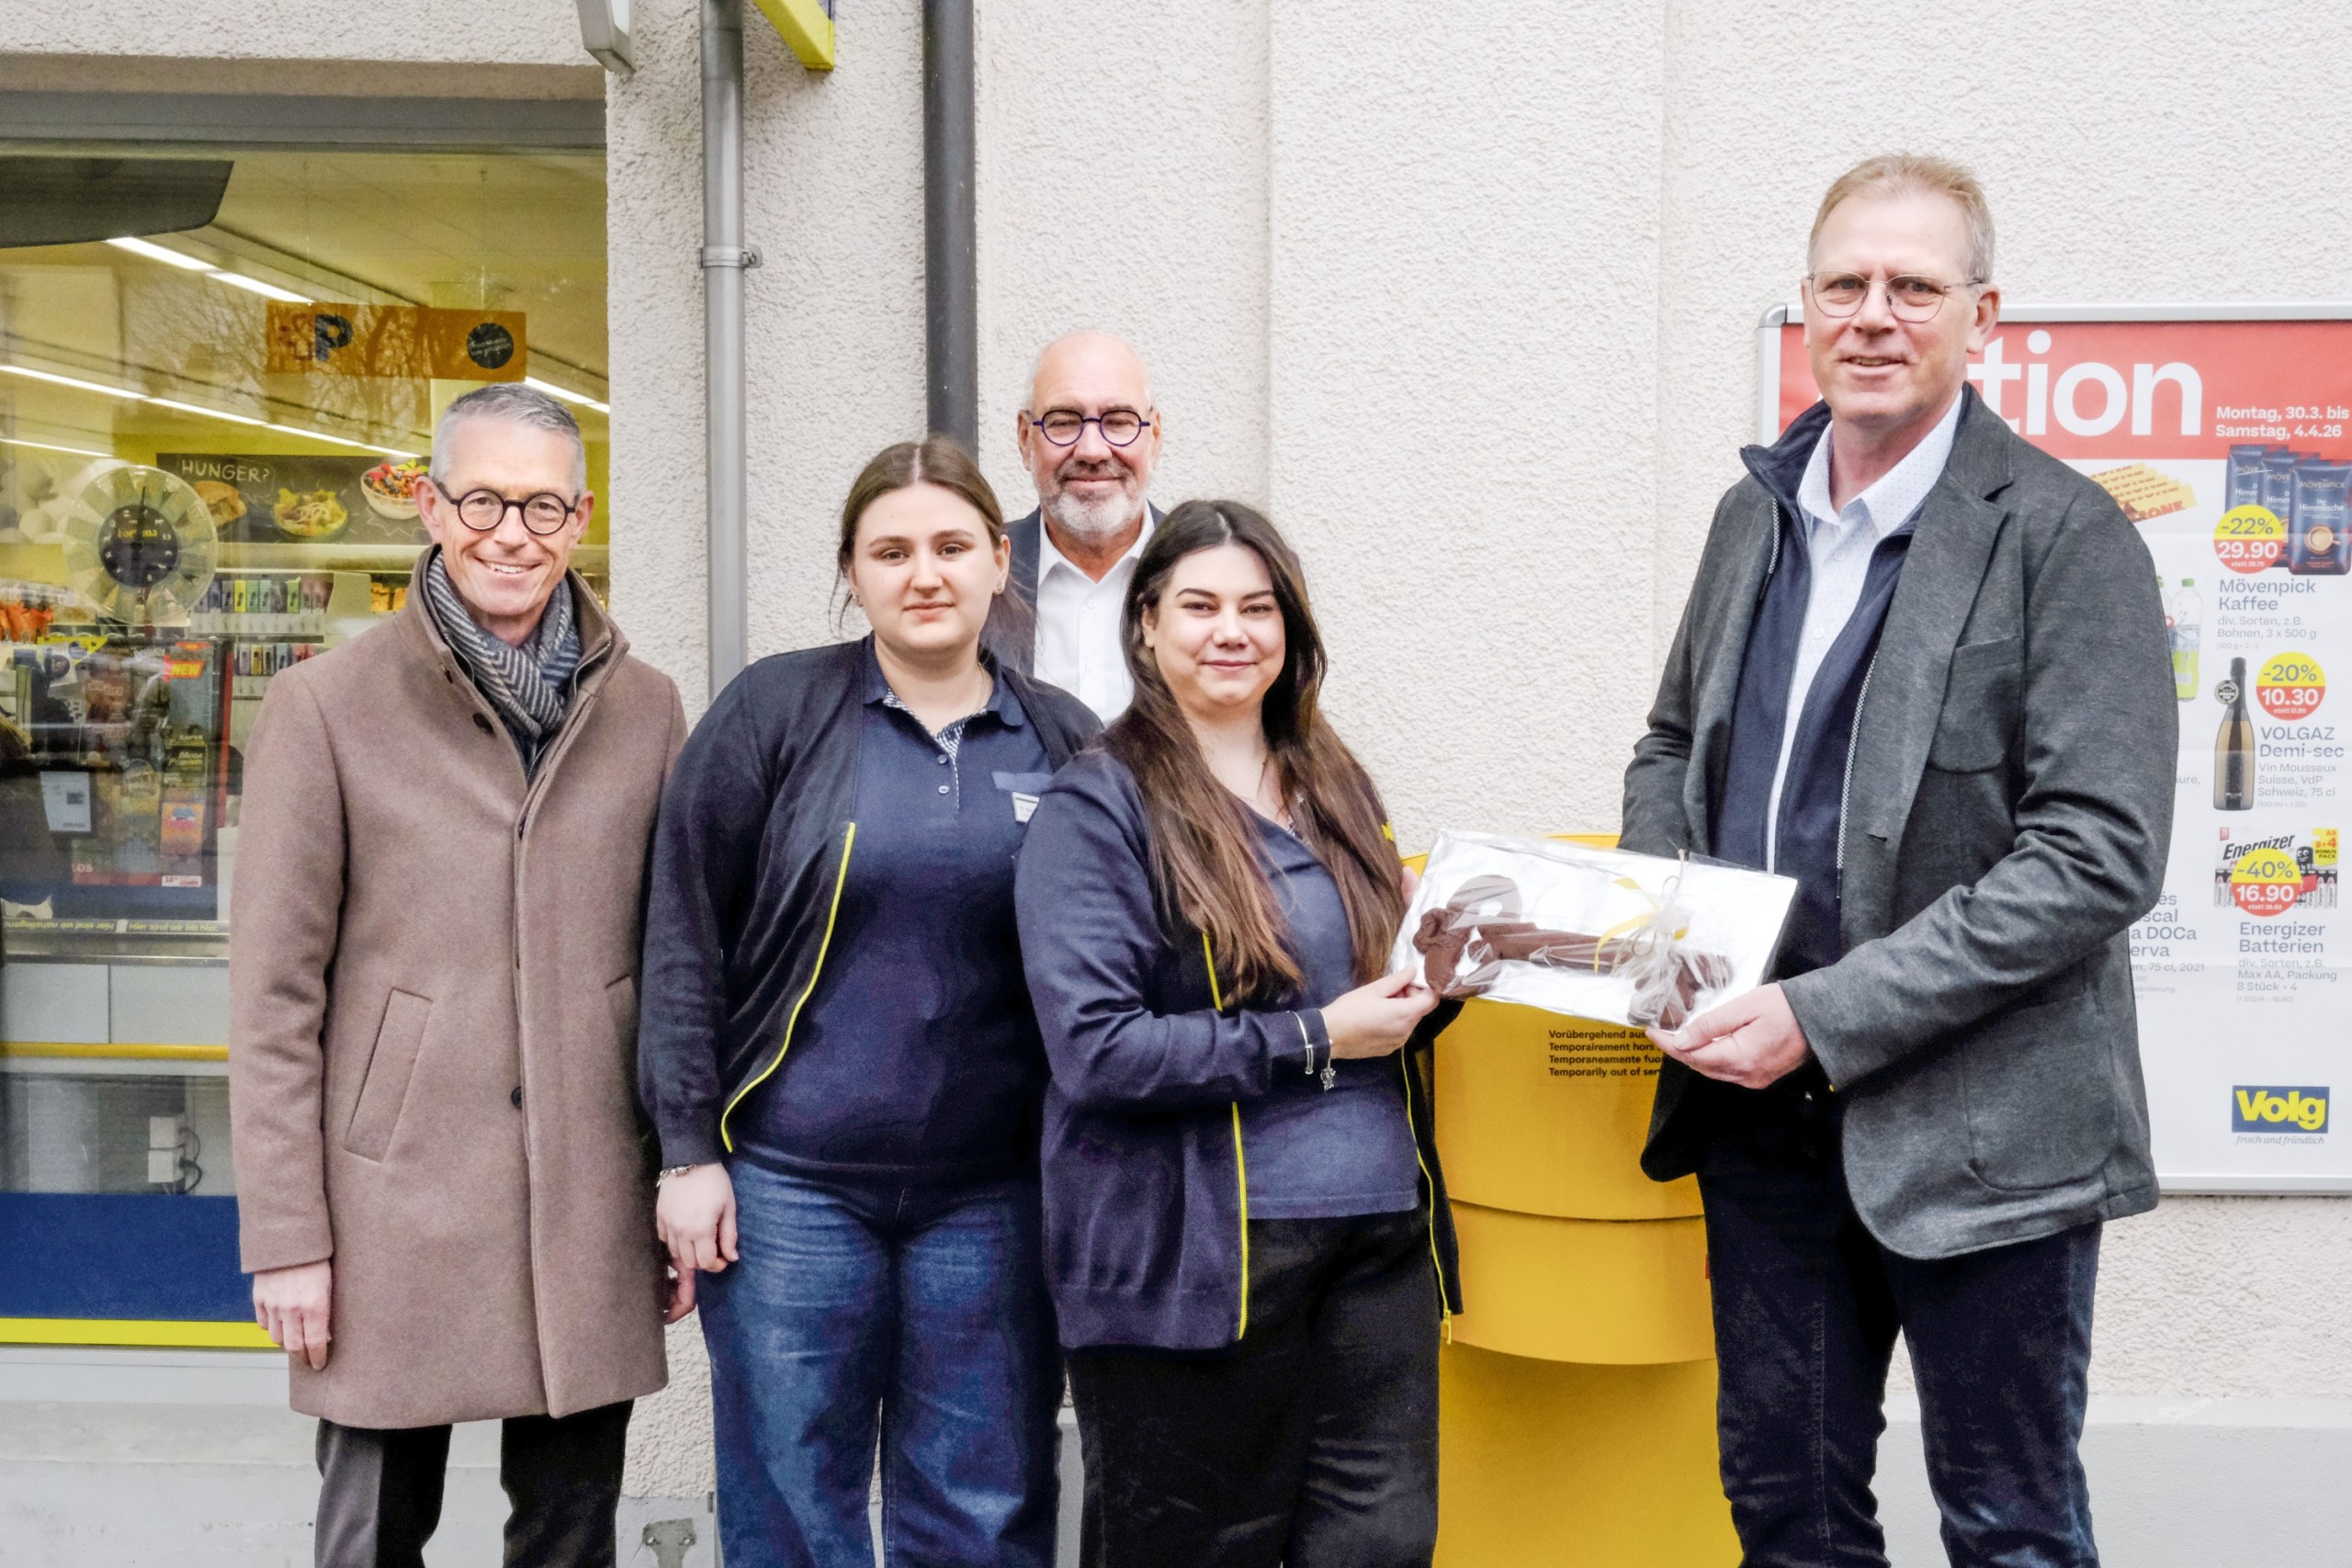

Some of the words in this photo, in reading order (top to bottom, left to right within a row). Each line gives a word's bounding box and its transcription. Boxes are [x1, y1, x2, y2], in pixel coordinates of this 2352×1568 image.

[2217, 406, 2282, 422] Montag,
[2286, 406, 2324, 419] 30.3.
[2327, 406, 2349, 419] bis
[2216, 424, 2290, 440] Samstag,
[2294, 424, 2342, 437] 4.4.26
[182, 460, 270, 482] HUNGER?
[2222, 517, 2274, 535] -22%
[2218, 541, 2278, 558] 29.90
[2220, 578, 2316, 596] Mövenpick
[2219, 596, 2278, 611] Kaffee
[2217, 616, 2237, 626] div.
[2239, 616, 2280, 626] Sorten,
[2283, 616, 2303, 626] z.B.
[2217, 628, 2264, 638] Bohnen,
[2267, 629, 2273, 637] 3
[2285, 629, 2307, 637] 500
[2309, 631, 2317, 640] g
[2263, 664, 2317, 682] -20%
[2262, 688, 2319, 705] 10.30
[2261, 727, 2335, 740] VOLGAZ
[2260, 743, 2345, 758] Demi-sec
[2259, 763, 2277, 773] Vin
[2279, 763, 2336, 773] Mousseux
[2258, 775, 2298, 785] Suisse,
[2301, 775, 2323, 784] VdP
[2257, 786, 2307, 797] Schweiz,
[2311, 787, 2323, 796] 75
[2325, 787, 2335, 796] cl
[2237, 861, 2293, 878] -40%
[2236, 885, 2294, 902] 16.90
[2138, 908, 2177, 922] scal
[2147, 927, 2197, 940] DOCa
[2240, 921, 2325, 940] Energizer
[2239, 939, 2324, 953] Batterien
[2179, 964, 2204, 972] 2021
[2238, 958, 2257, 968] div.
[2260, 958, 2302, 969] Sorten,
[2305, 959, 2325, 968] z.B.
[2238, 971, 2262, 979] Max
[2265, 971, 2284, 980] AA,
[2287, 971, 2337, 982] Packung
[2237, 982, 2245, 991] 8
[2246, 982, 2278, 991] Stück
[1549, 1030, 1626, 1040] Vorübergehend
[1549, 1043, 1630, 1052] Temporairement
[1549, 1055, 1641, 1065] Temporaneamente
[1549, 1067, 1607, 1077] Temporarily
[1631, 1067, 1640, 1076] of
[2236, 1090, 2325, 1130] Volg
[2235, 1135, 2261, 1145] frisch
[2264, 1136, 2281, 1145] und
